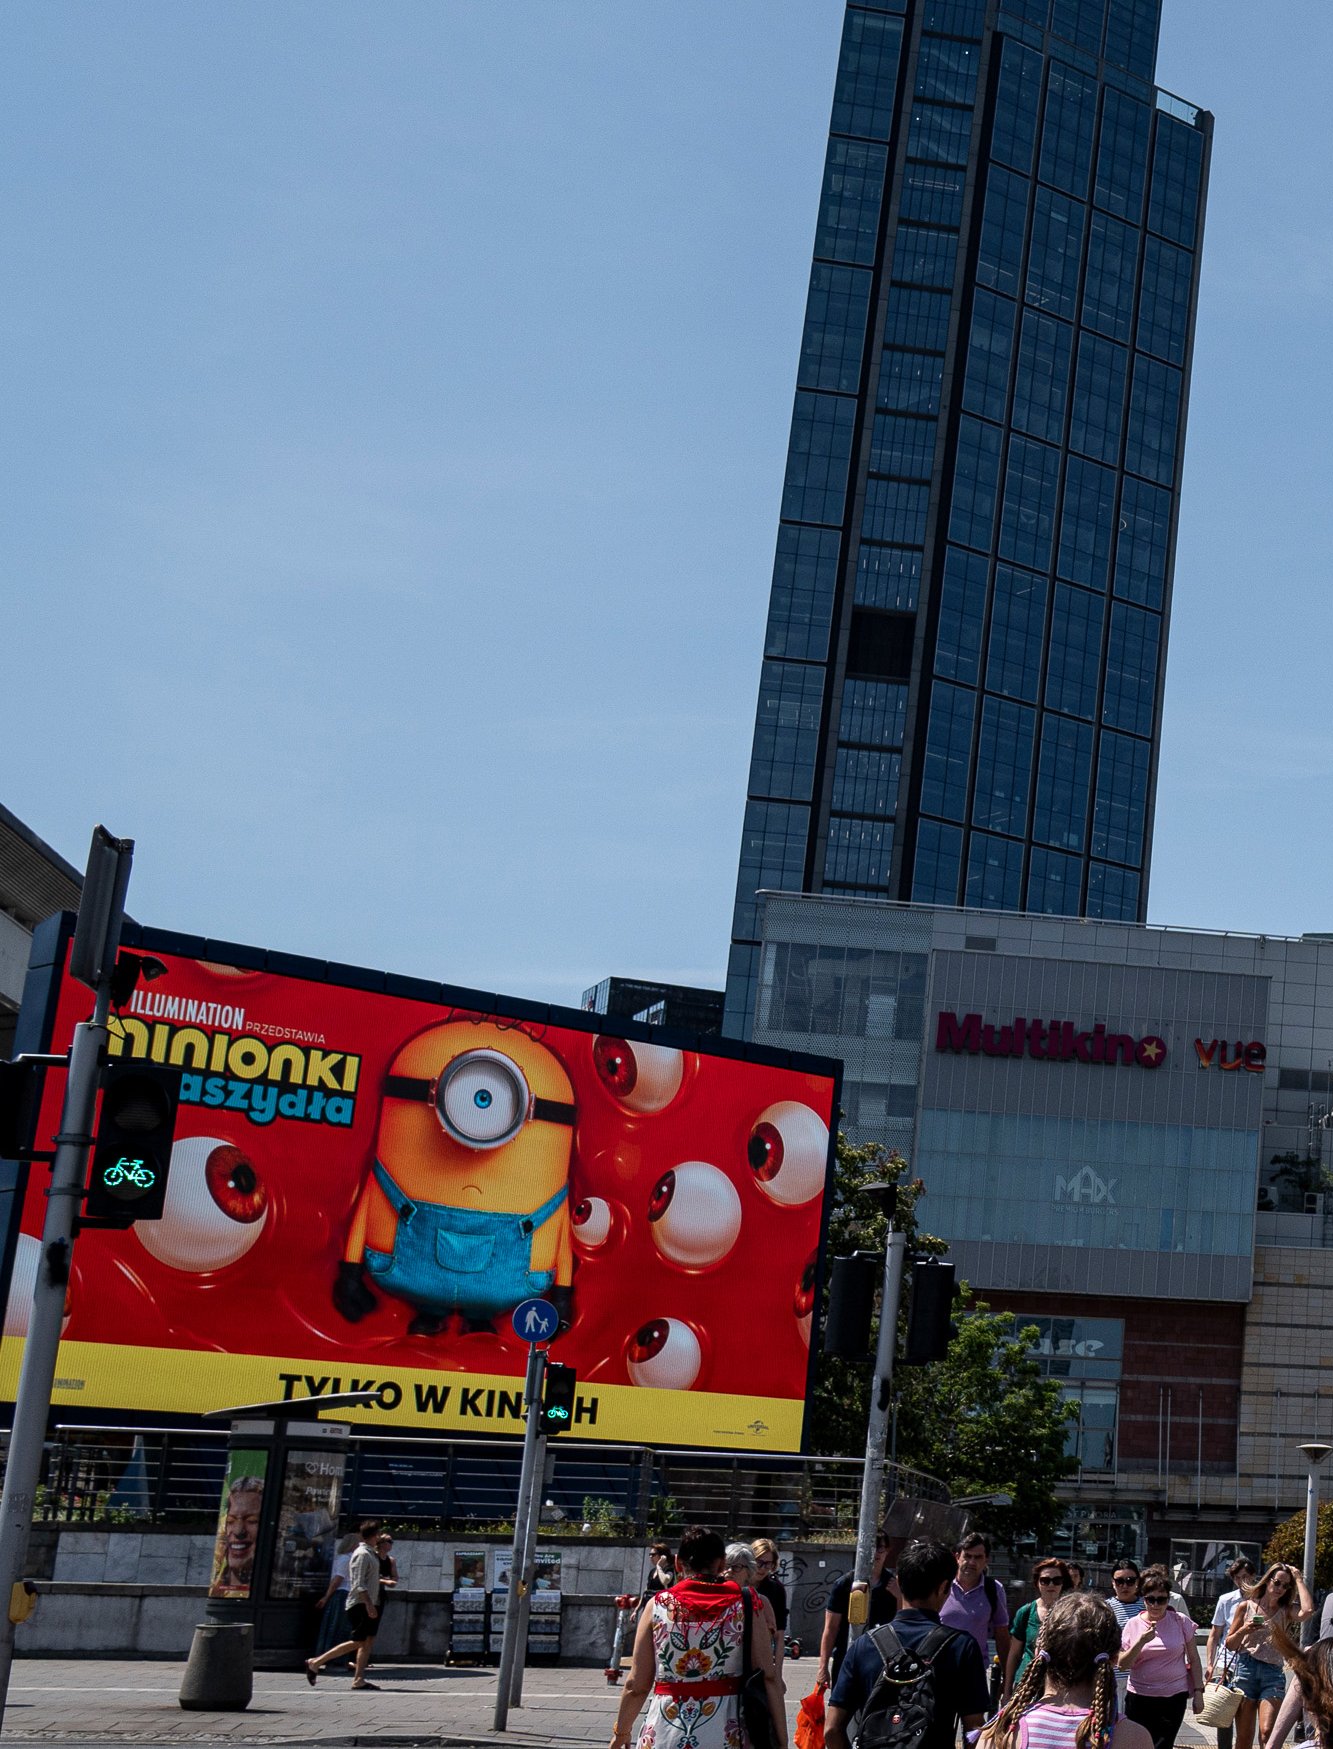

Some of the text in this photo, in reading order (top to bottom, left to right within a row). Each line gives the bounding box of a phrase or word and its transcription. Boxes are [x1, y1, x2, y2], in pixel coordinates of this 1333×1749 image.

[130, 990, 245, 1031] ILLUMINATION
[245, 1021, 325, 1044] PRZEDSTAWIA
[935, 1011, 1167, 1067] Multikino
[1195, 1038, 1267, 1072] vue
[179, 1073, 354, 1125] aszydła
[1054, 1165, 1119, 1204] MAX
[413, 1383, 452, 1414] W
[458, 1387, 599, 1425] KINH
